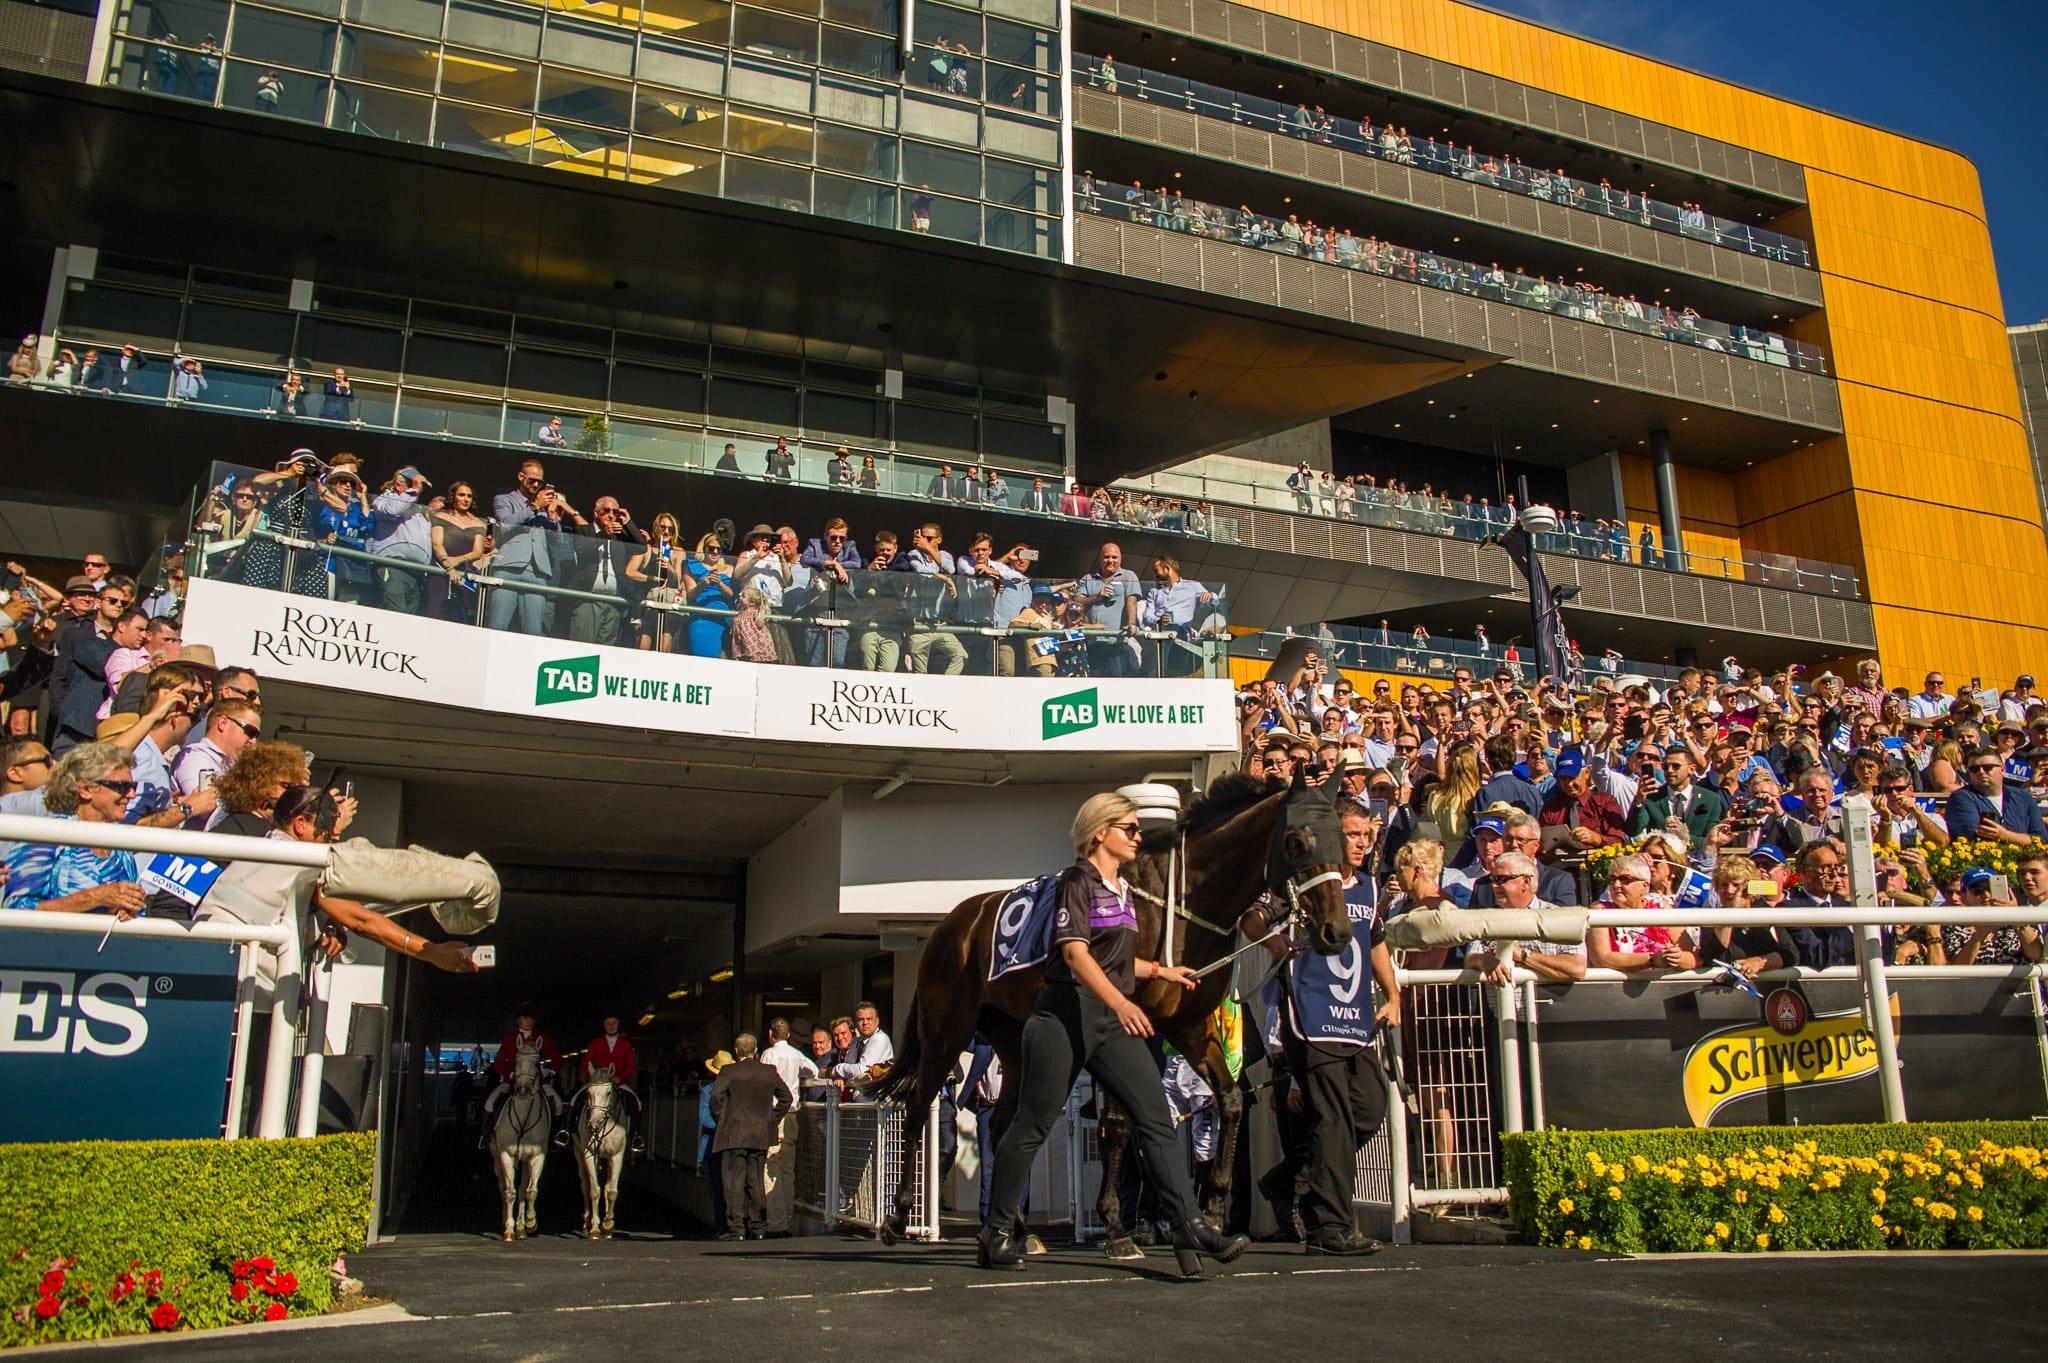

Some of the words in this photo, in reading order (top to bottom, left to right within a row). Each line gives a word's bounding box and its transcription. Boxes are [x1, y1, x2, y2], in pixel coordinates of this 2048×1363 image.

[281, 606, 380, 644] ROYAL
[251, 630, 427, 681] RANDWICK
[544, 667, 594, 694] TAB
[604, 675, 628, 697] WE
[631, 678, 669, 701] LOVE
[672, 682, 682, 703] A
[686, 685, 713, 706] BET
[832, 680, 914, 708] ROYAL
[809, 703, 958, 732] RANDWICK
[1047, 704, 1094, 724] TAB
[1103, 705, 1126, 723] WE
[1130, 705, 1163, 723] LOVE
[1168, 705, 1177, 723] A
[1180, 705, 1205, 723] BET
[152, 875, 166, 885] GO
[166, 881, 188, 897] WINX
[1326, 935, 1363, 1004] 9
